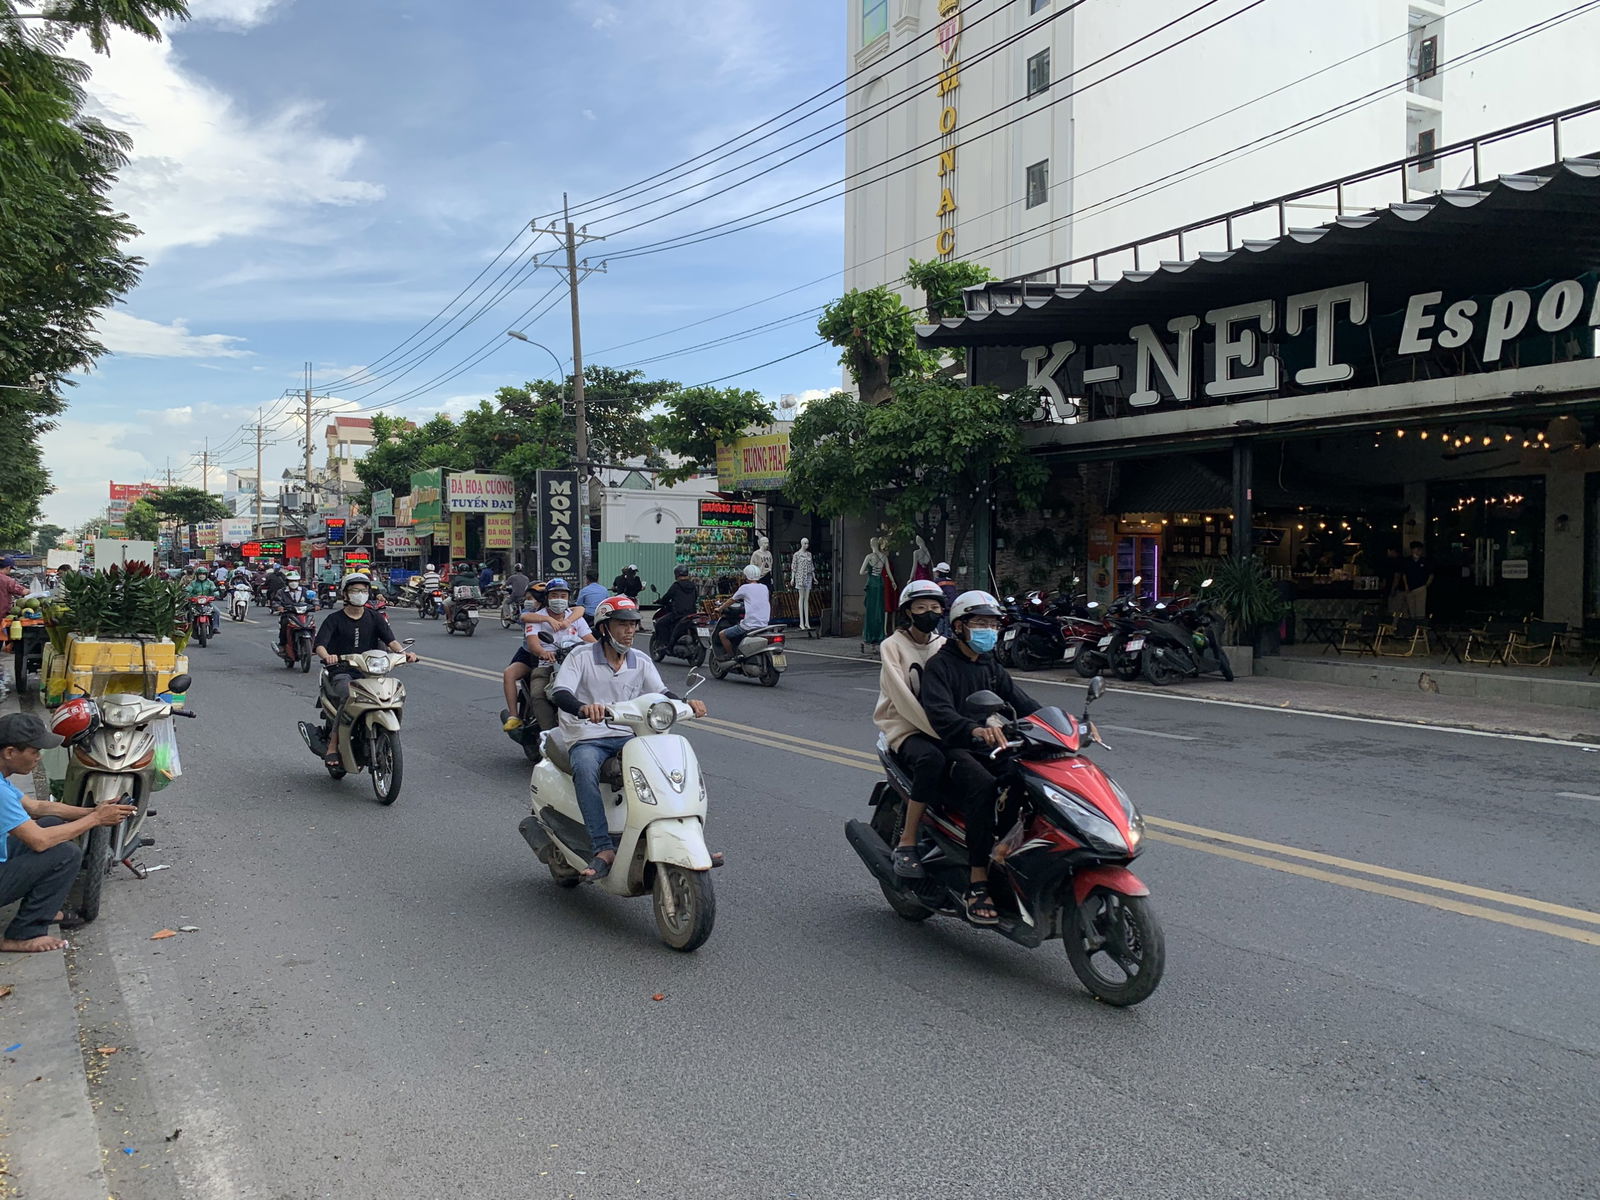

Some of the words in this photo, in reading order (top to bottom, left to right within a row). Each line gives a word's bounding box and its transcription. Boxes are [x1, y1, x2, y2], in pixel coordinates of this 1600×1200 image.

[1019, 281, 1368, 421] K-NET
[452, 495, 488, 508] TUYẾN
[492, 500, 513, 511] ĐẠT
[465, 479, 483, 495] HOA
[548, 480, 572, 572] MONACO
